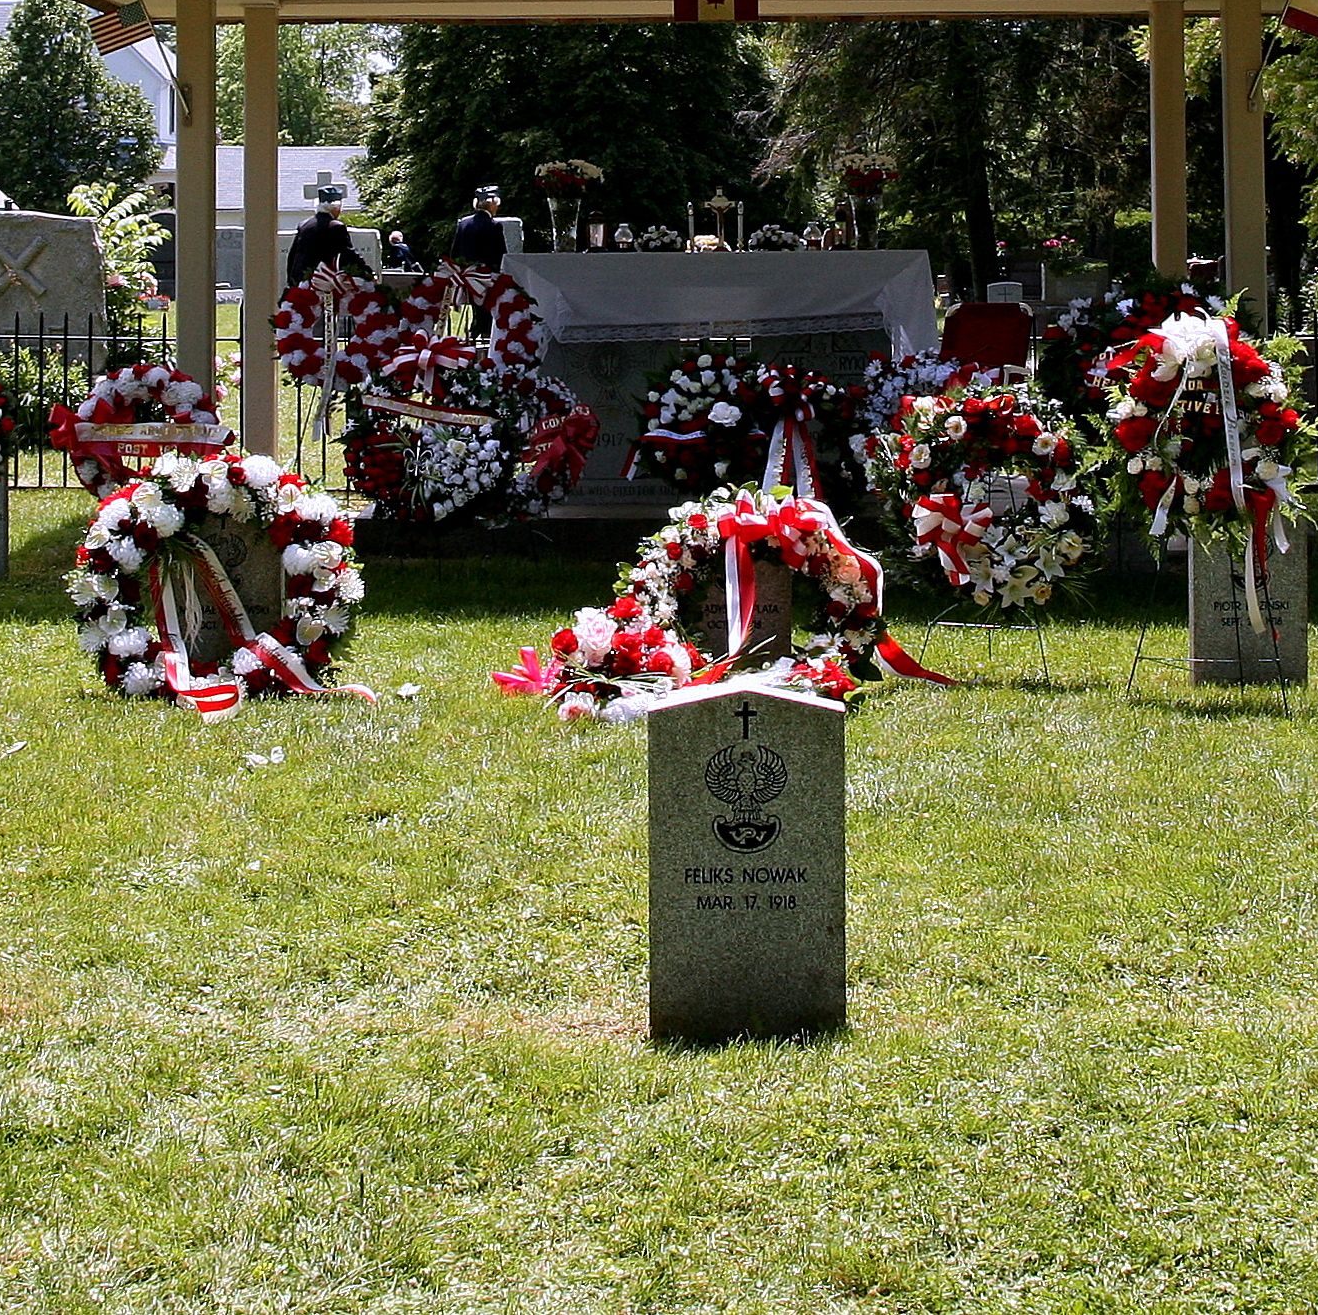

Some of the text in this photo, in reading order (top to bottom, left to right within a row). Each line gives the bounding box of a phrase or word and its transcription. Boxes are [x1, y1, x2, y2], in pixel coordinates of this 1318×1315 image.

[116, 442, 149, 455] POST
[1213, 600, 1242, 612] PIOTR
[684, 867, 808, 884] FELIKS NOWAK
[696, 895, 736, 910] MAR.
[769, 895, 797, 910] 1918
